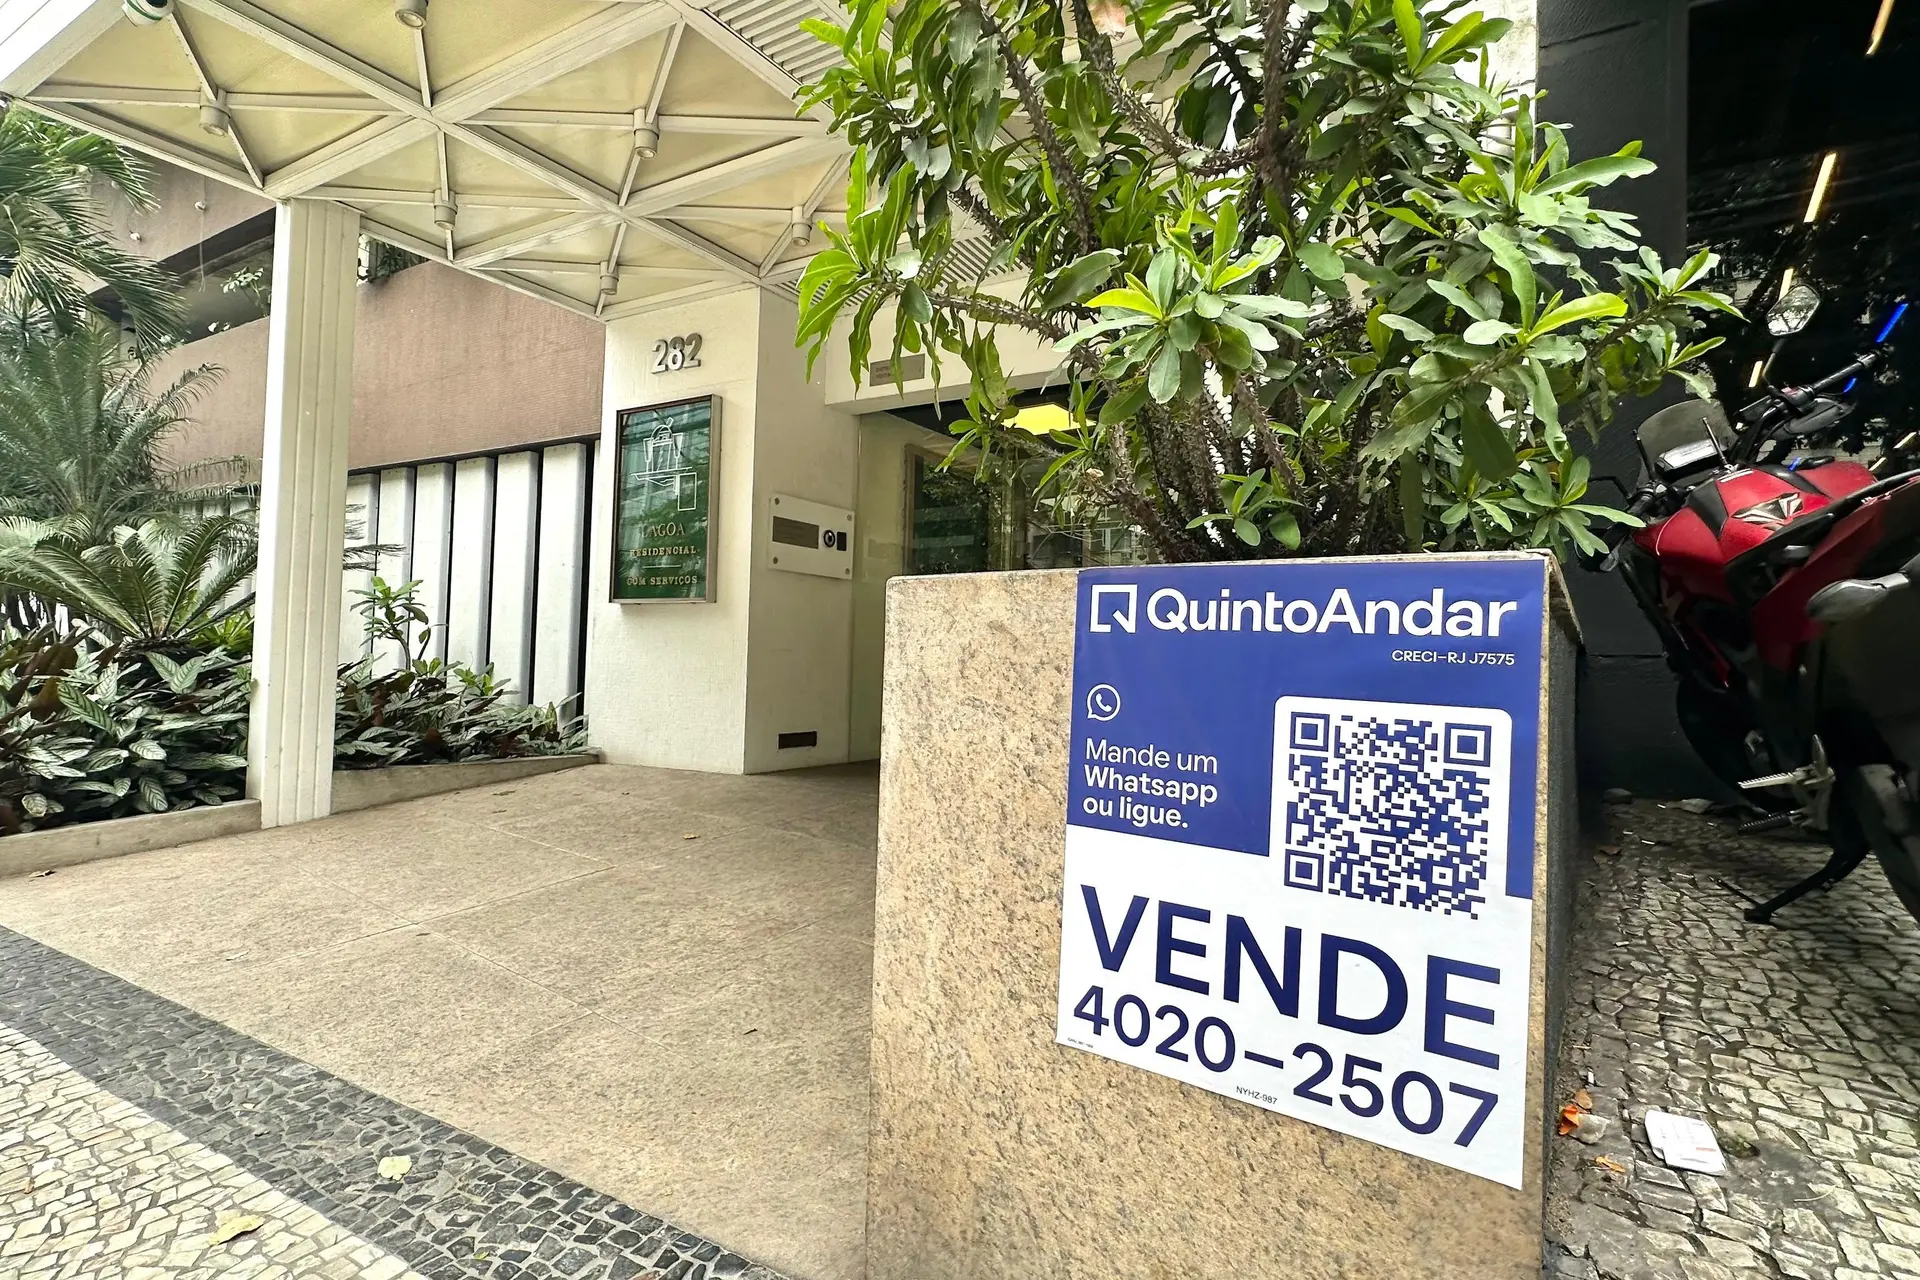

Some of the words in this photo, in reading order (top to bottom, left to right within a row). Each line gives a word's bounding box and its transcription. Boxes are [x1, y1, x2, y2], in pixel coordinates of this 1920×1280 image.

[651, 333, 702, 374] 282
[641, 522, 686, 538] LAGOA
[630, 545, 697, 557] RESIDENCIAL
[627, 577, 646, 586] COM
[650, 575, 698, 586] SERVIÇOS
[1146, 587, 1517, 638] QuintoAndar
[1391, 649, 1466, 665] CRECI-RJ
[1469, 651, 1515, 667] J7575
[1085, 737, 1171, 769] Mande
[1176, 752, 1218, 775] um
[1083, 765, 1219, 809] Whatsapp
[1082, 798, 1116, 817] ou
[1118, 797, 1189, 830] ligue.
[1080, 884, 1501, 1071] VENDE
[1073, 984, 1499, 1148] 4020-2507
[1236, 1085, 1278, 1105] NYHZ-987
